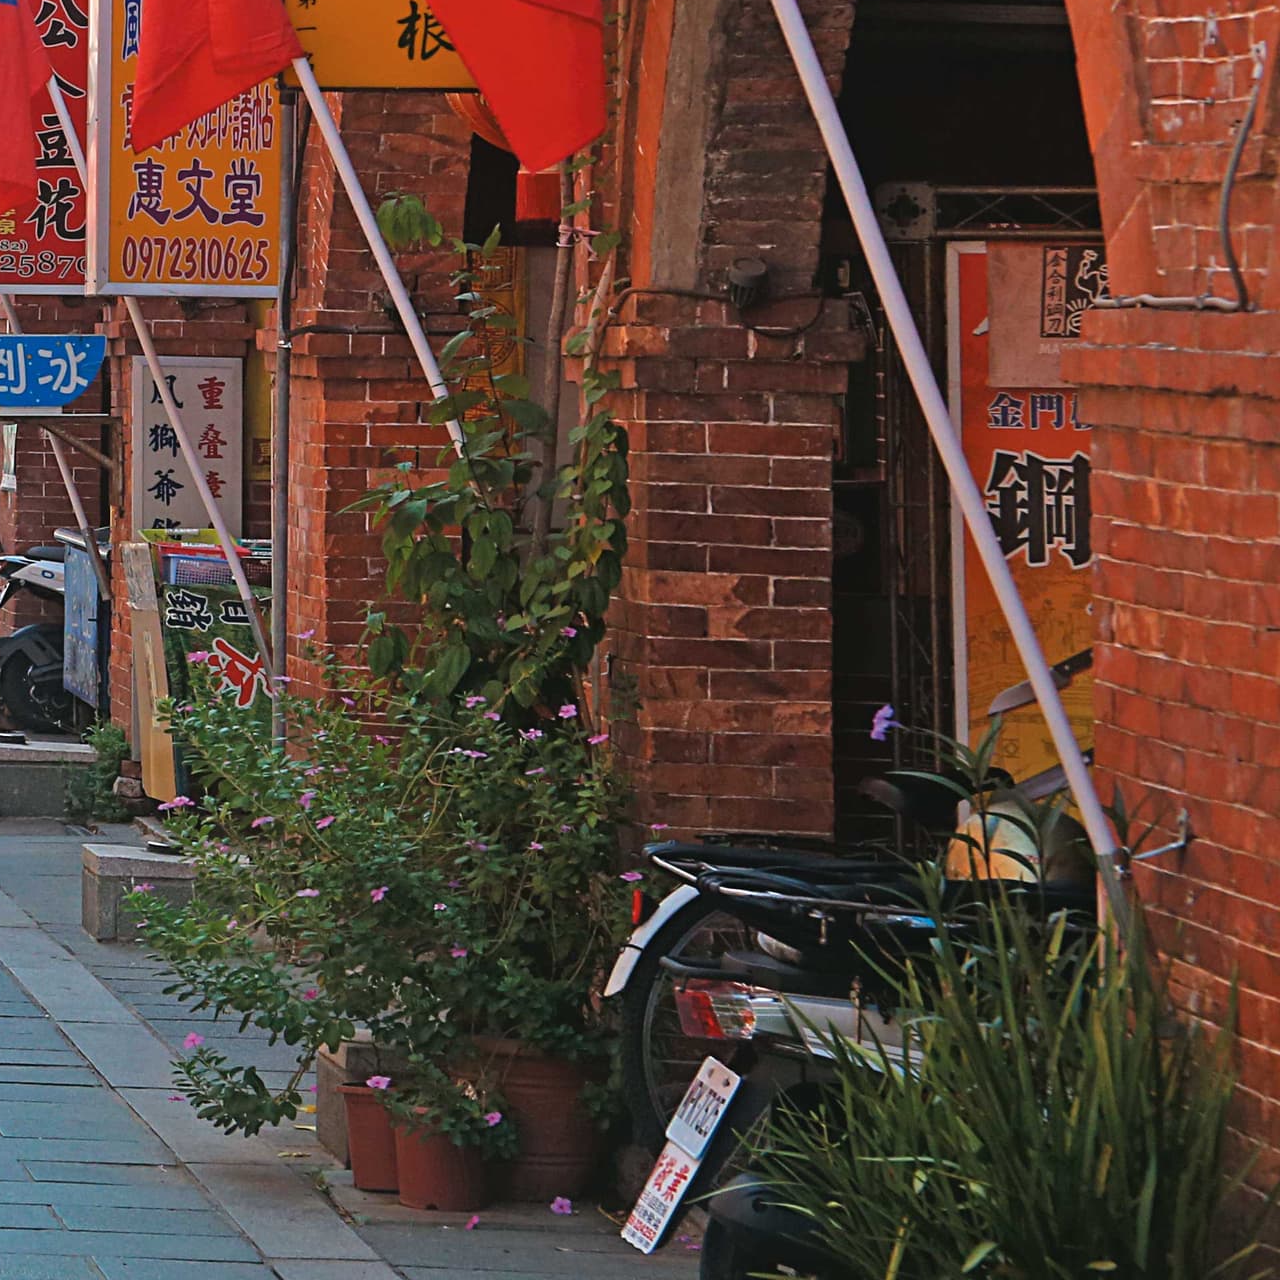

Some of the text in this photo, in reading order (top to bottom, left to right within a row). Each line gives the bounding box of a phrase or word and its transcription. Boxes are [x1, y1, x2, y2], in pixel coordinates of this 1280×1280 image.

[127, 156, 266, 227] 惠文堂
[121, 235, 270, 281] 0972310625
